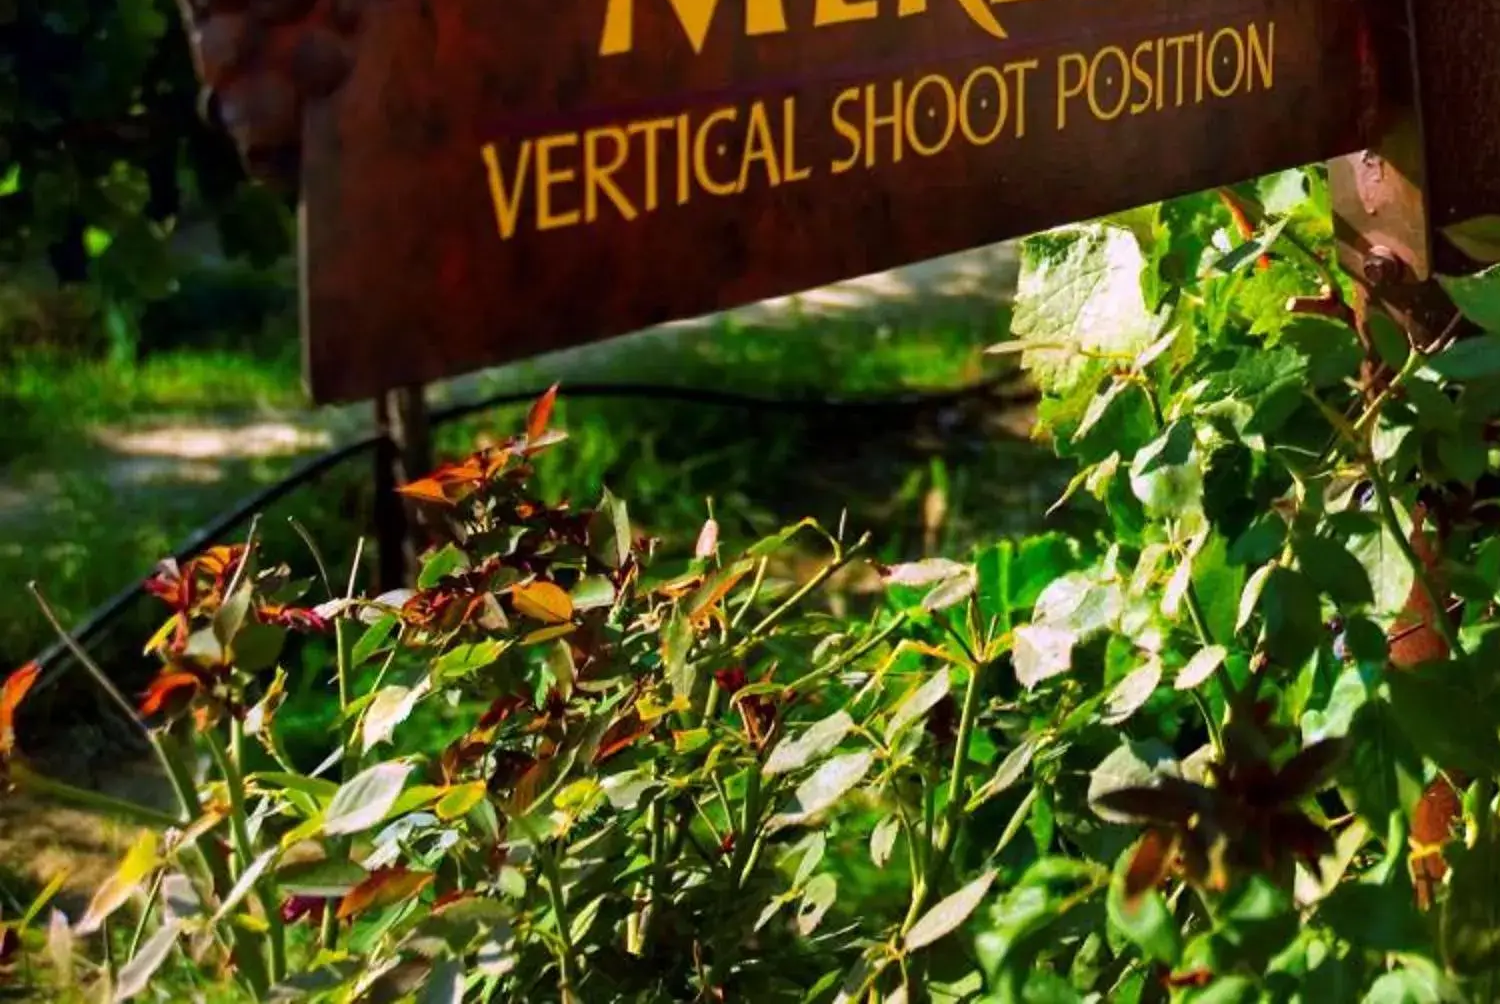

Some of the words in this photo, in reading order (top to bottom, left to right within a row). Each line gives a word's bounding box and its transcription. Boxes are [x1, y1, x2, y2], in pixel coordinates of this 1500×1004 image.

[481, 96, 812, 240] VERTICAL
[830, 58, 1039, 173] SHOOT
[1056, 22, 1275, 130] POSITION
